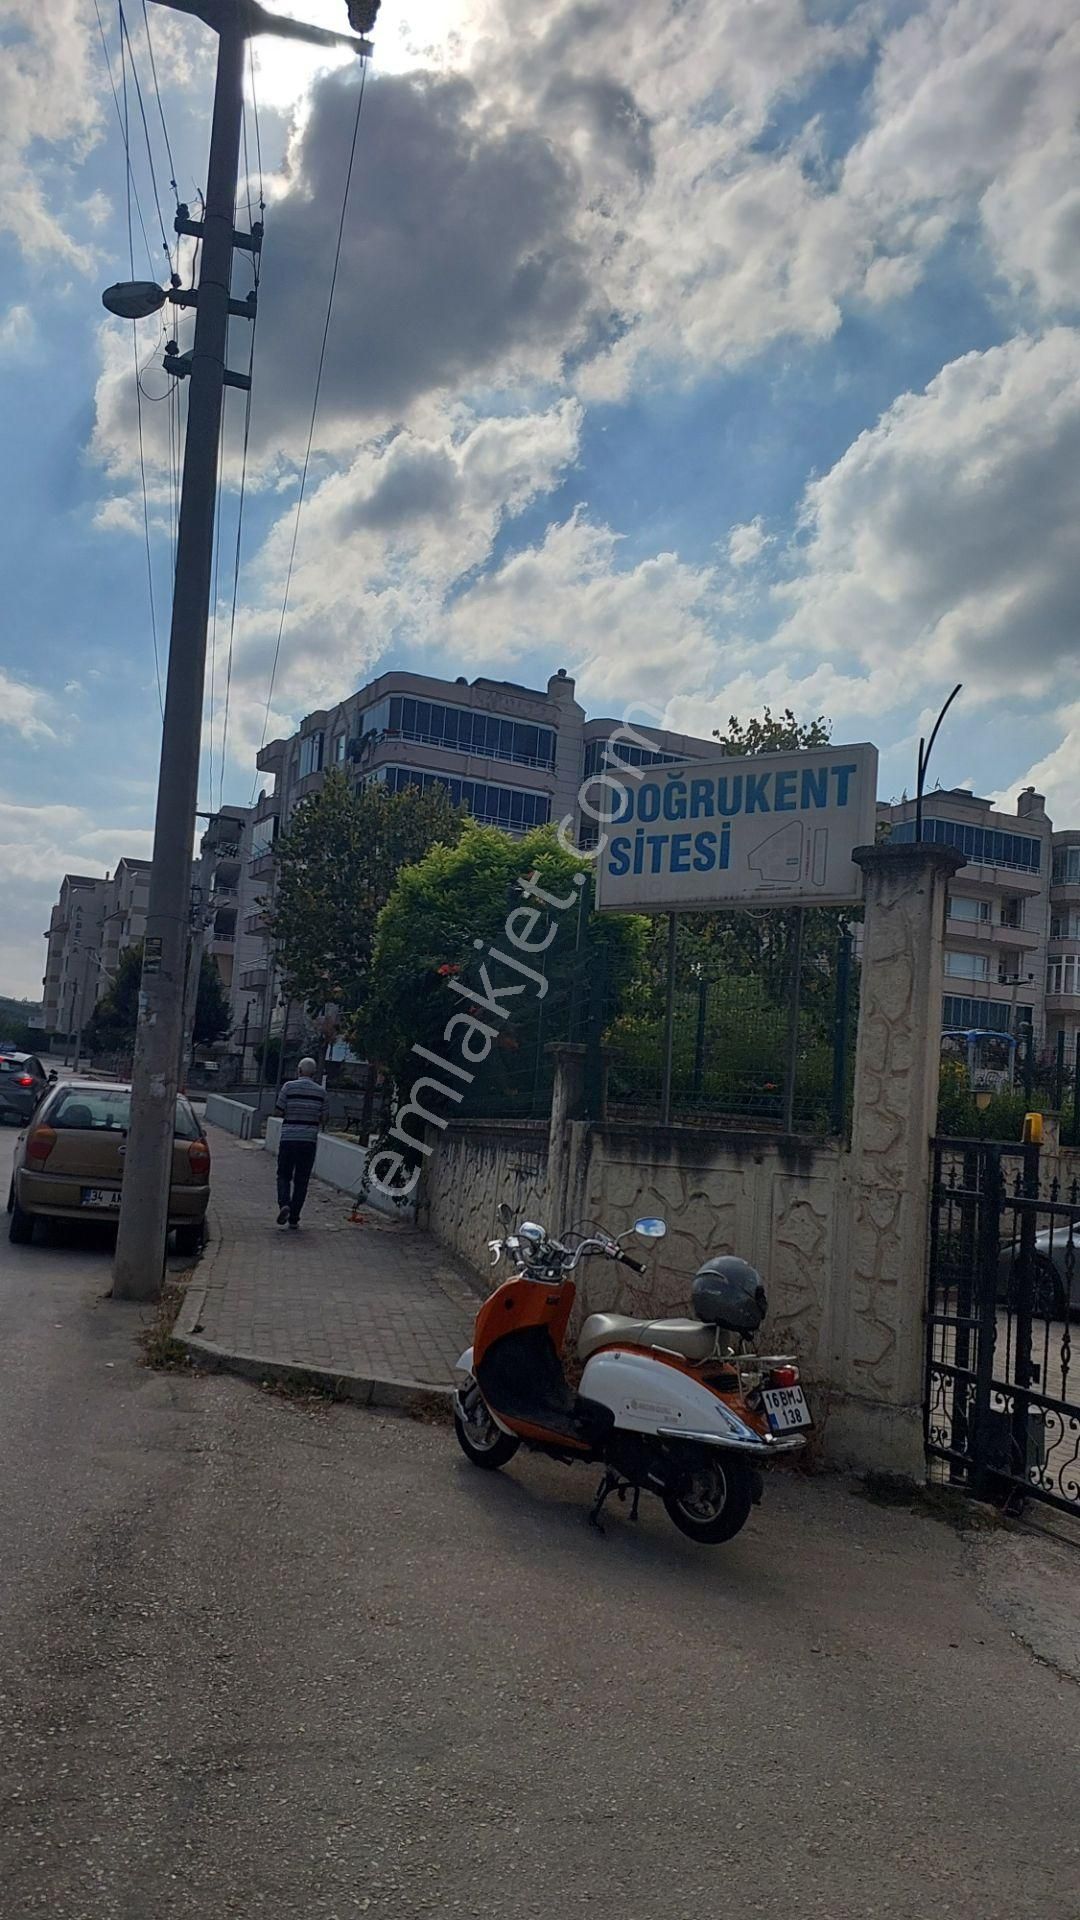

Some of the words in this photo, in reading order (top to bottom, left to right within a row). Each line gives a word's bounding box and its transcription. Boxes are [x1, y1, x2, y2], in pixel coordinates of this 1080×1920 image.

[609, 764, 857, 825] DOĞRUKENT
[608, 822, 731, 876] SİTESİ
[782, 1408, 803, 1426] 138
